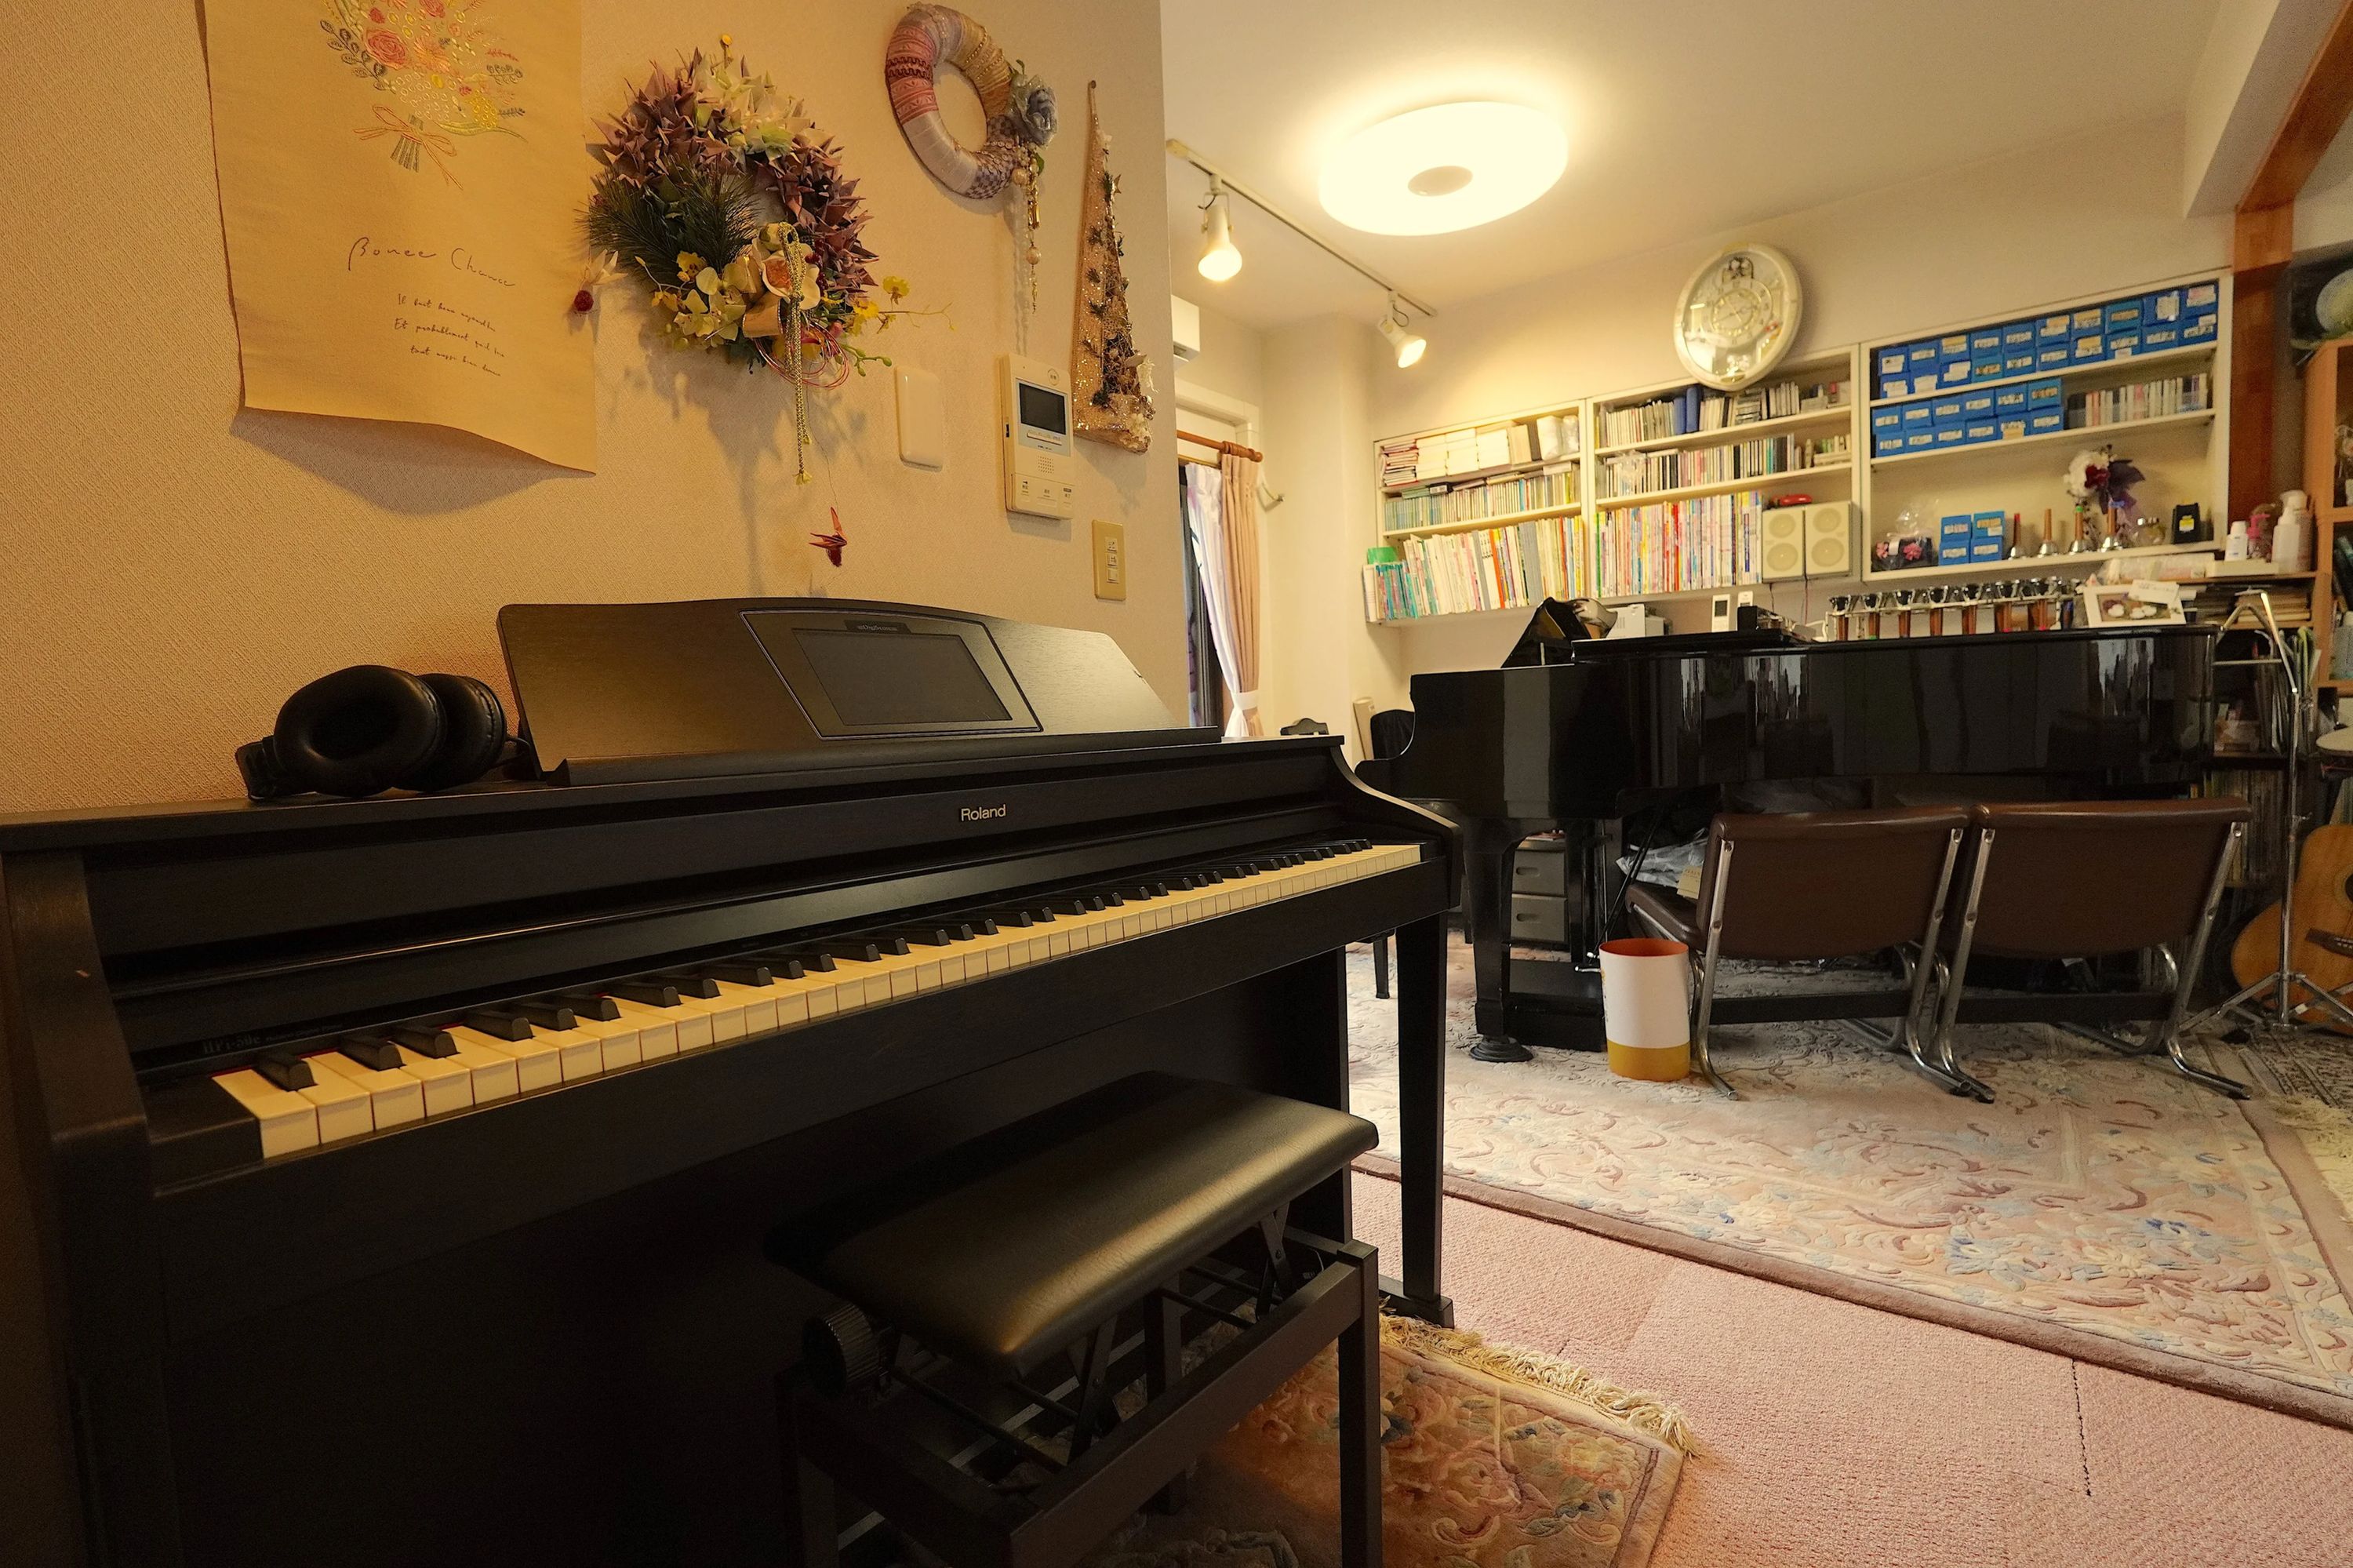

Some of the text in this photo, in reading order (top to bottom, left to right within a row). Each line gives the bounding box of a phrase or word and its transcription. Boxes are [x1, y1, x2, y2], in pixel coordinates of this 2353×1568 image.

[398, 293, 406, 305] Il
[395, 318, 408, 329] Et
[961, 803, 1006, 822] Roland
